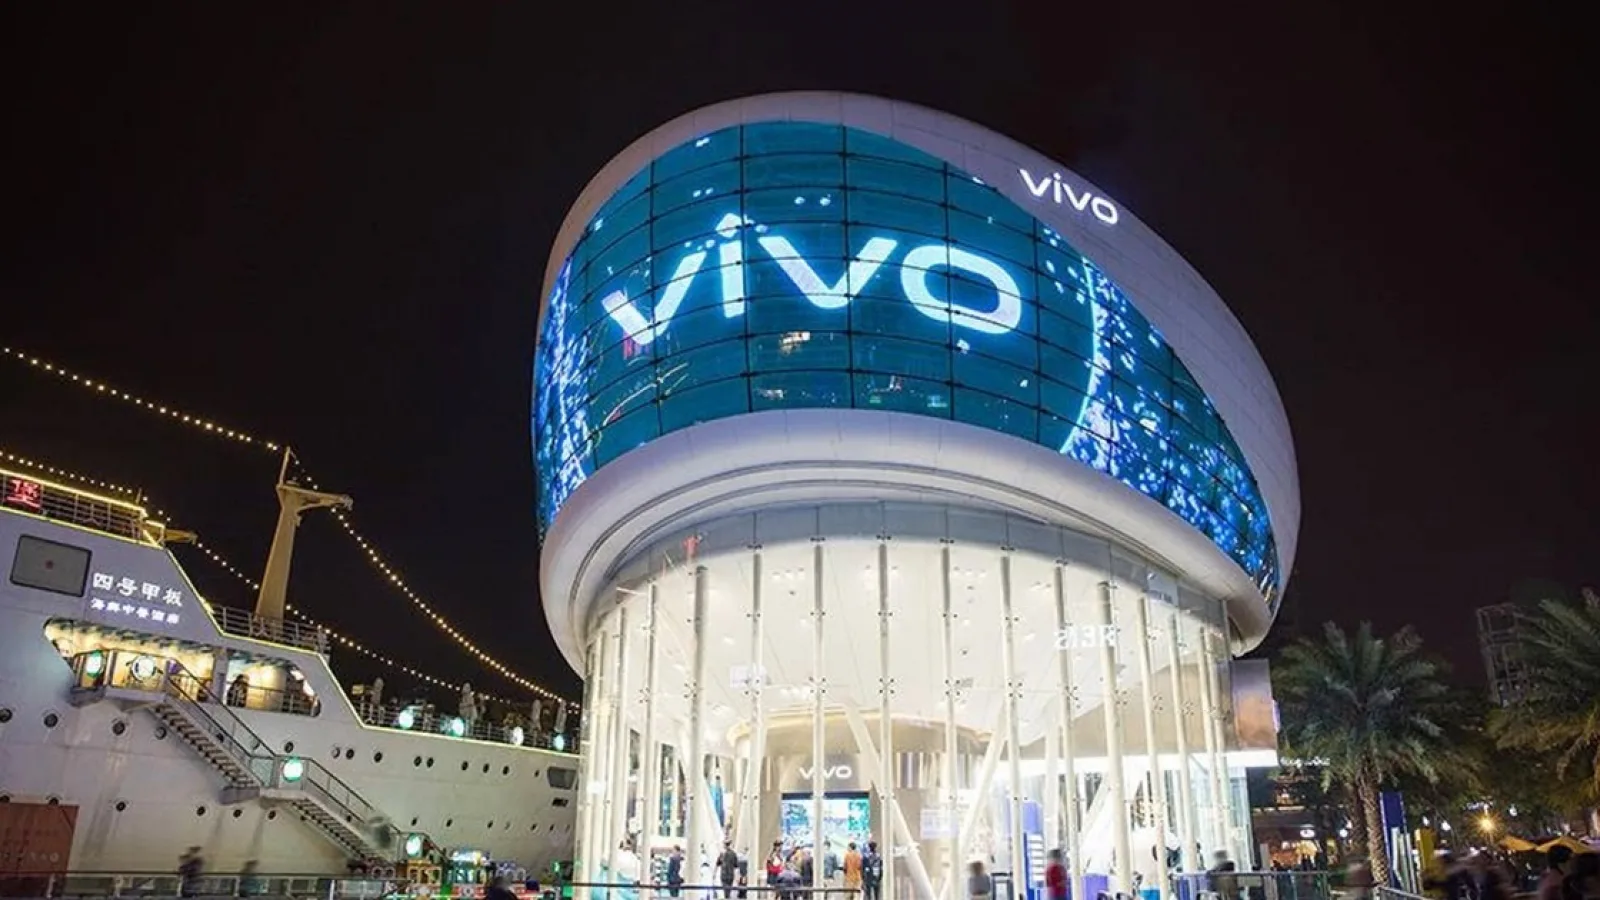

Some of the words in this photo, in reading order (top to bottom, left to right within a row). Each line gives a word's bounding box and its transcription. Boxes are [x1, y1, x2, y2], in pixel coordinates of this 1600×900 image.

[1019, 168, 1119, 225] vivo
[601, 212, 1022, 345] vivo
[92, 572, 183, 607] 四号甲板
[799, 765, 852, 780] vvo
